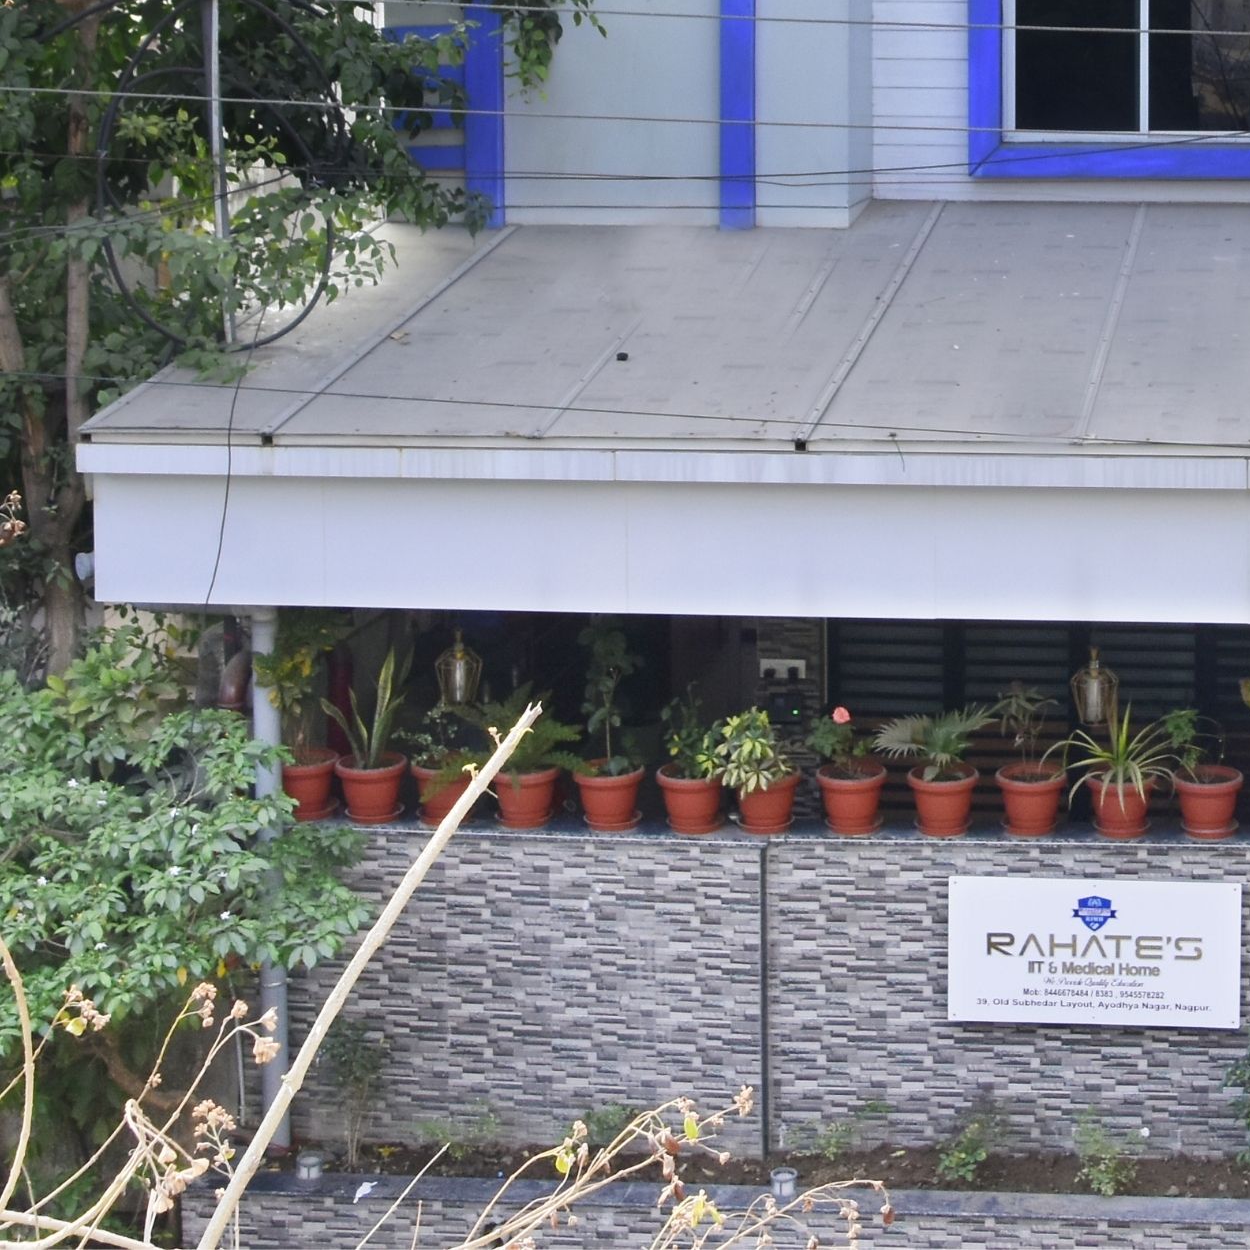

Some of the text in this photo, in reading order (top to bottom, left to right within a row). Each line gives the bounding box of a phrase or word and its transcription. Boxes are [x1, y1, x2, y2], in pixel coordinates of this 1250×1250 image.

[986, 932, 1203, 961] RAHATE'S
[1028, 961, 1160, 977] IIT & Medical Home
[993, 998, 1010, 1006] Old
[1012, 999, 1057, 1007] Subhedar
[1060, 1000, 1095, 1009] Layout,
[1098, 1001, 1139, 1010] Ayodhya
[1142, 1002, 1172, 1012] Nagar,
